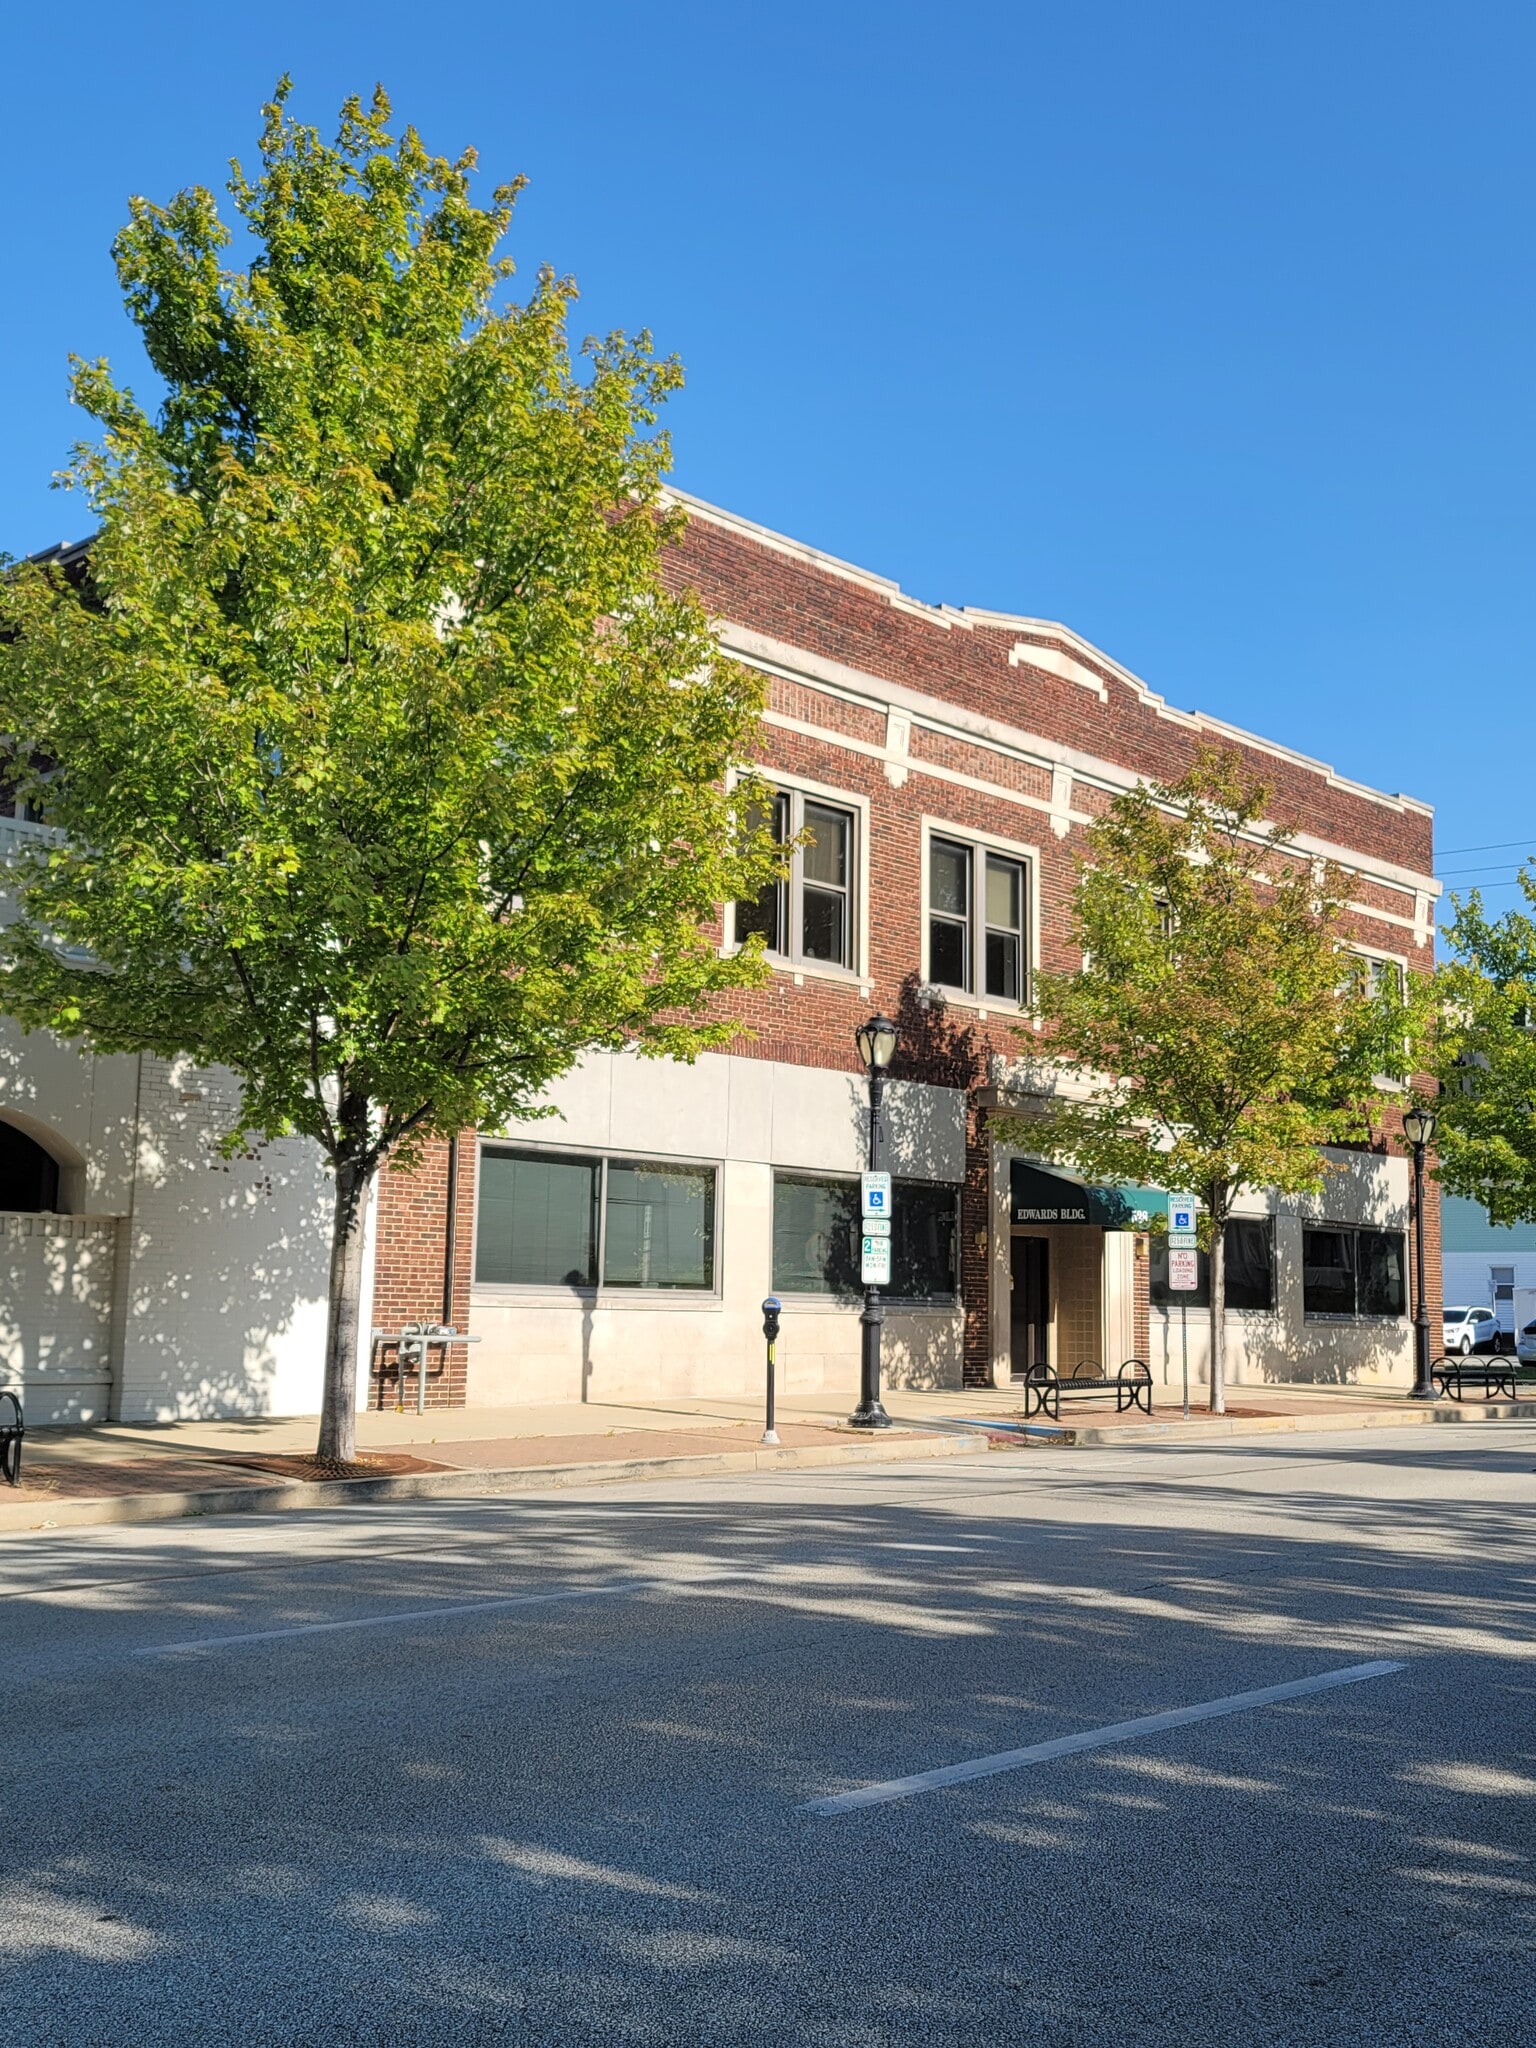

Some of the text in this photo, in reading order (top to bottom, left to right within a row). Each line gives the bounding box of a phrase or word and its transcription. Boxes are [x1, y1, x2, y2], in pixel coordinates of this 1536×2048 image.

[1017, 1208, 1086, 1220] EDWARDS BLDG.
[864, 1239, 871, 1252] 2
[1177, 1252, 1188, 1260] NO
